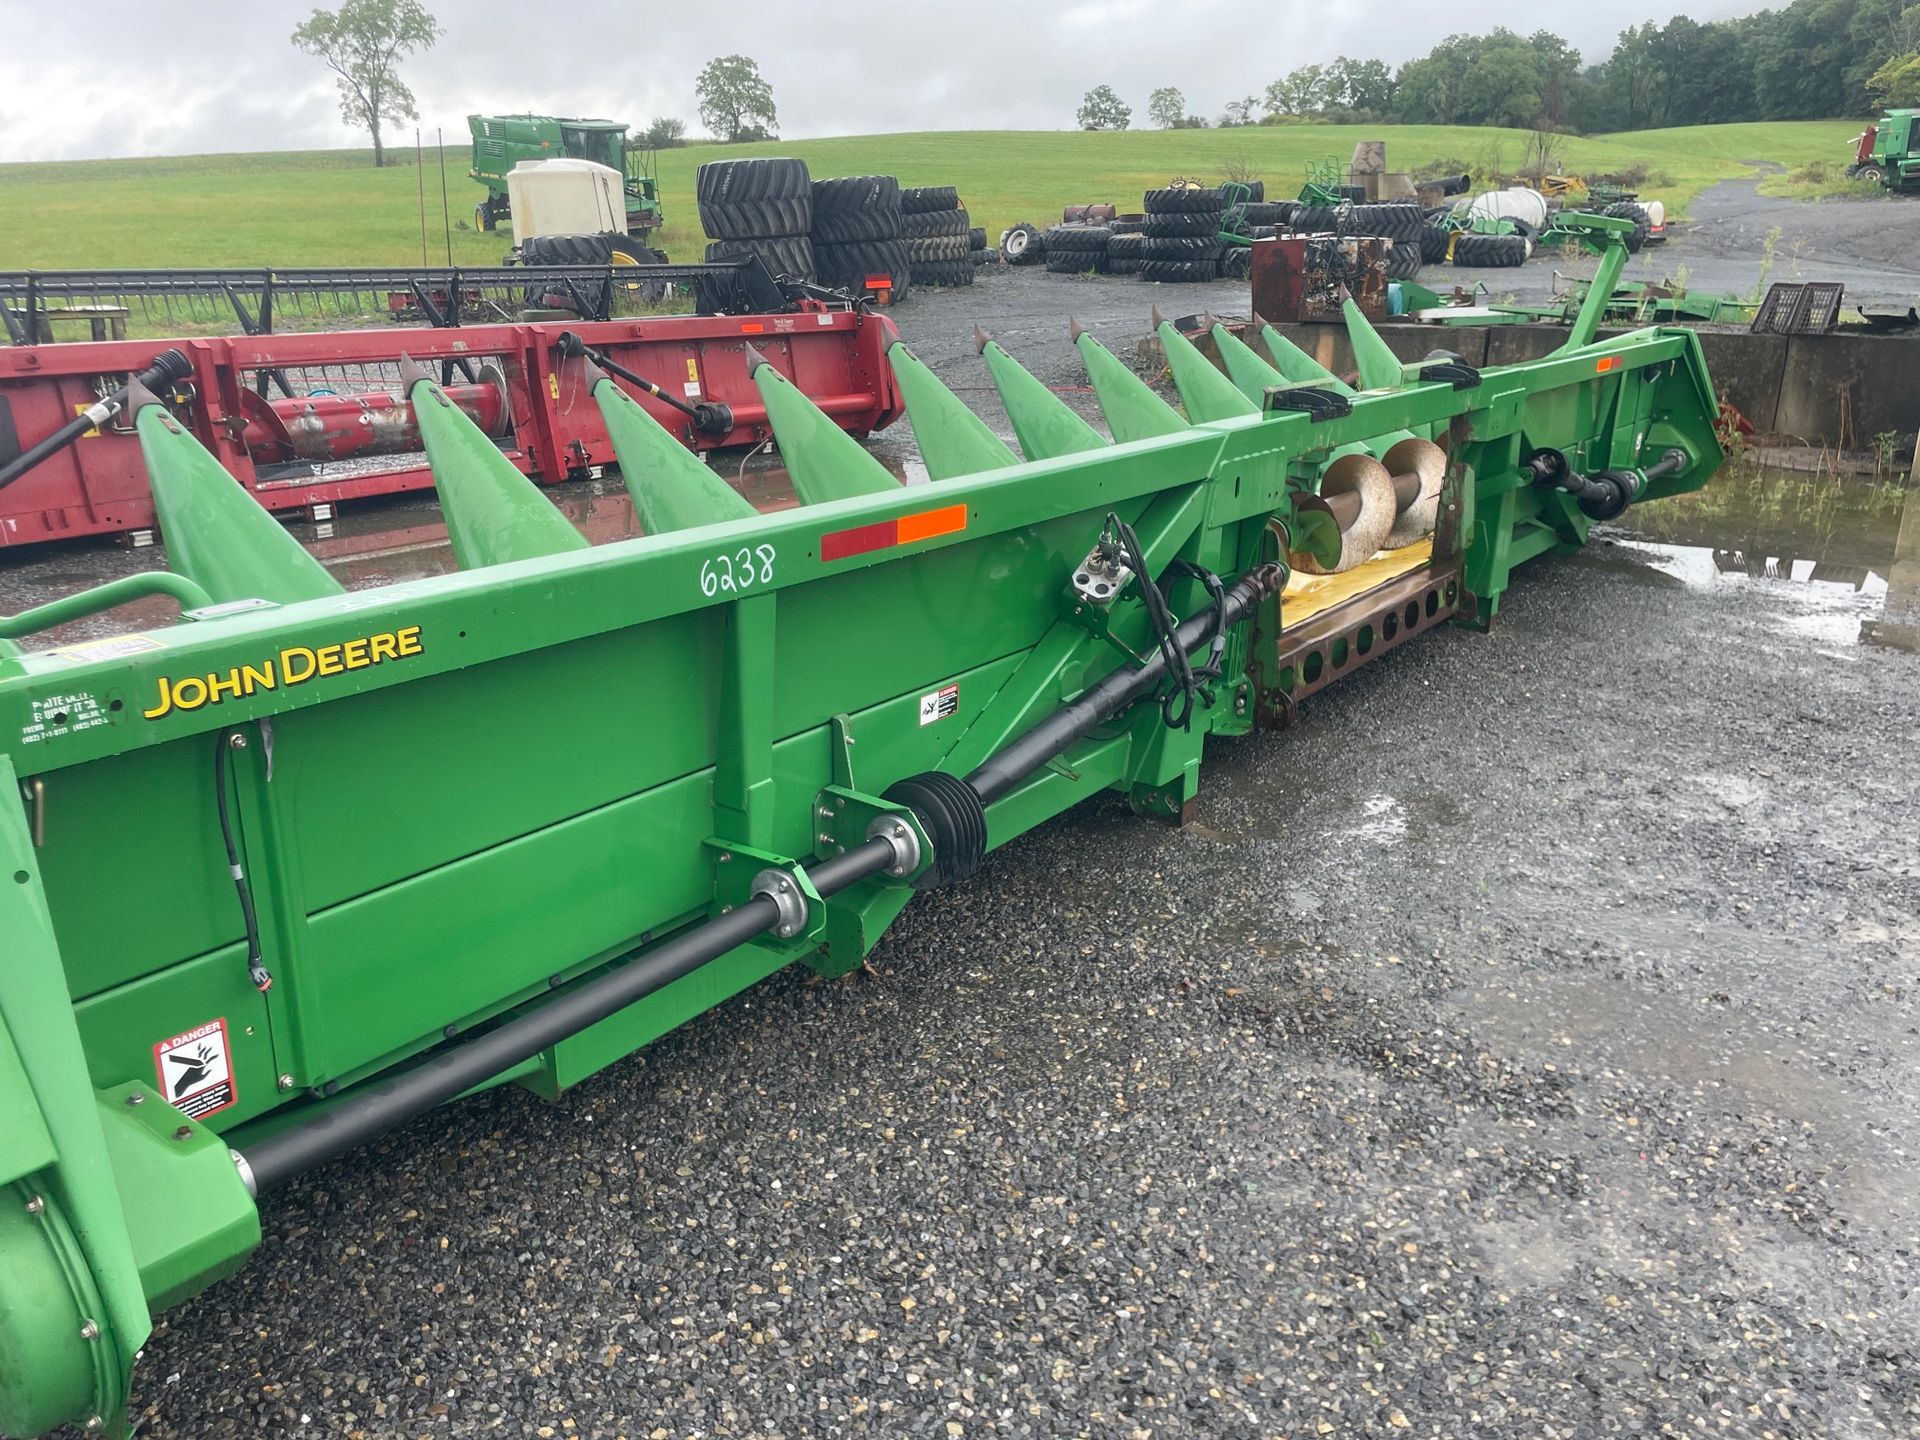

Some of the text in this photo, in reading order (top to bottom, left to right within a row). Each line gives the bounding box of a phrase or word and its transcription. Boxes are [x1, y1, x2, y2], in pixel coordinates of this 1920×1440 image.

[700, 543, 776, 597] 6238
[144, 625, 423, 720] JOHN DEERE
[171, 1021, 221, 1047] DANGER
